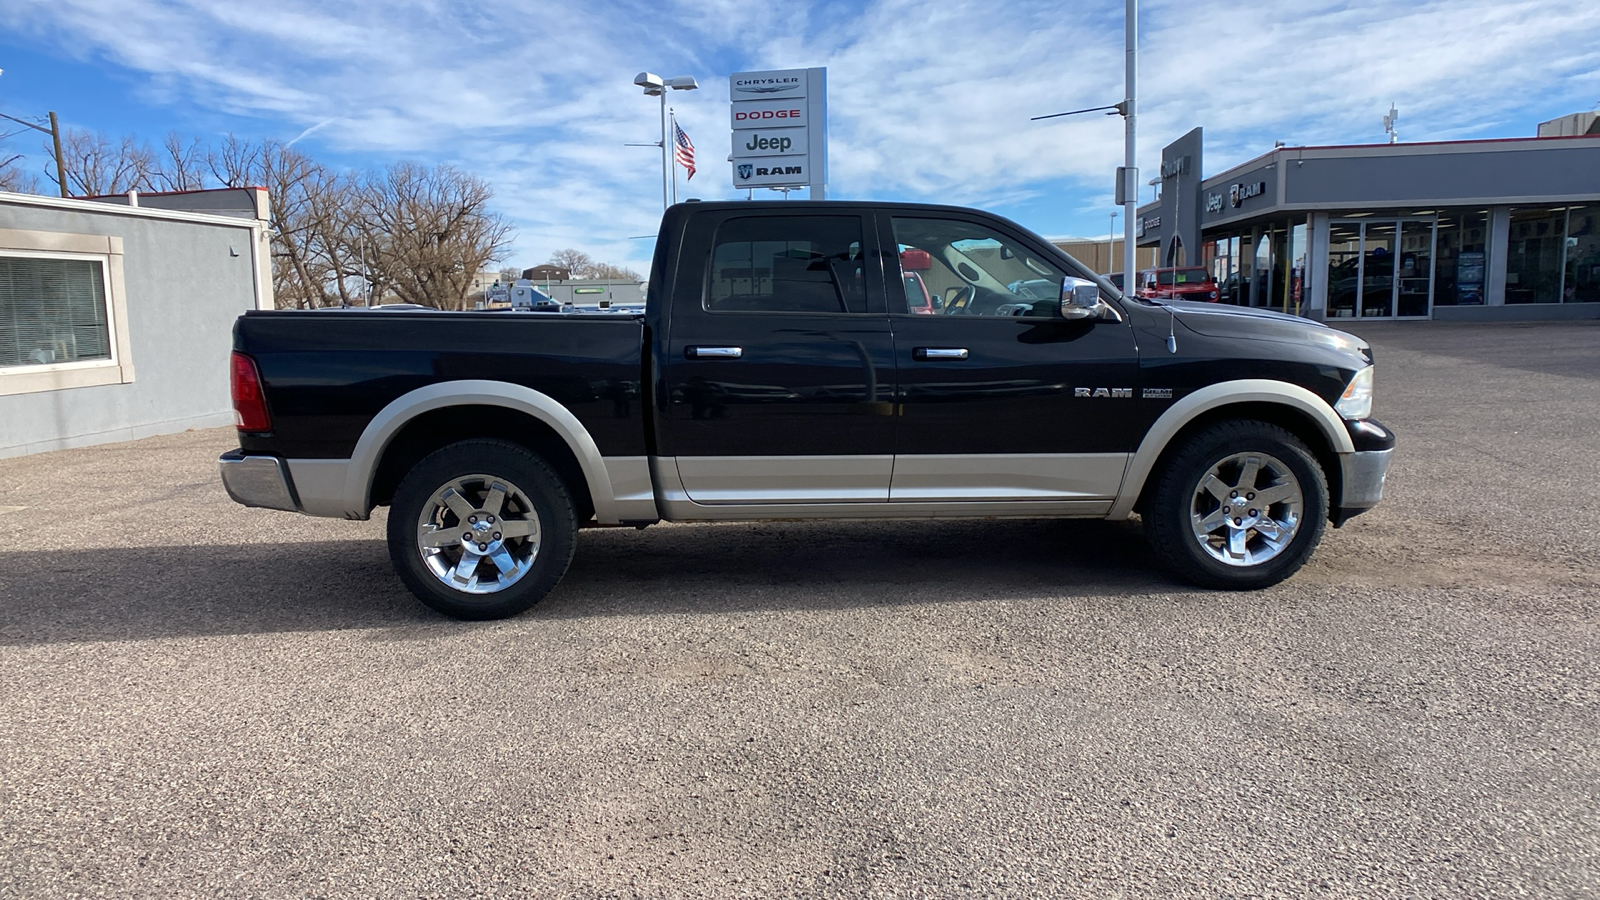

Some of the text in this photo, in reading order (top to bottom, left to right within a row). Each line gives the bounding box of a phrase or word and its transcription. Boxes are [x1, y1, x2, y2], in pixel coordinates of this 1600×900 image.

[736, 77, 798, 86] CHRYSLER
[735, 109, 801, 121] DODGE
[746, 134, 792, 152] Jeep
[756, 166, 802, 176] RAM
[1239, 182, 1261, 200] RAM
[1206, 192, 1223, 213] Jeep
[1144, 217, 1160, 229] DODGE
[1074, 387, 1133, 398] RAM
